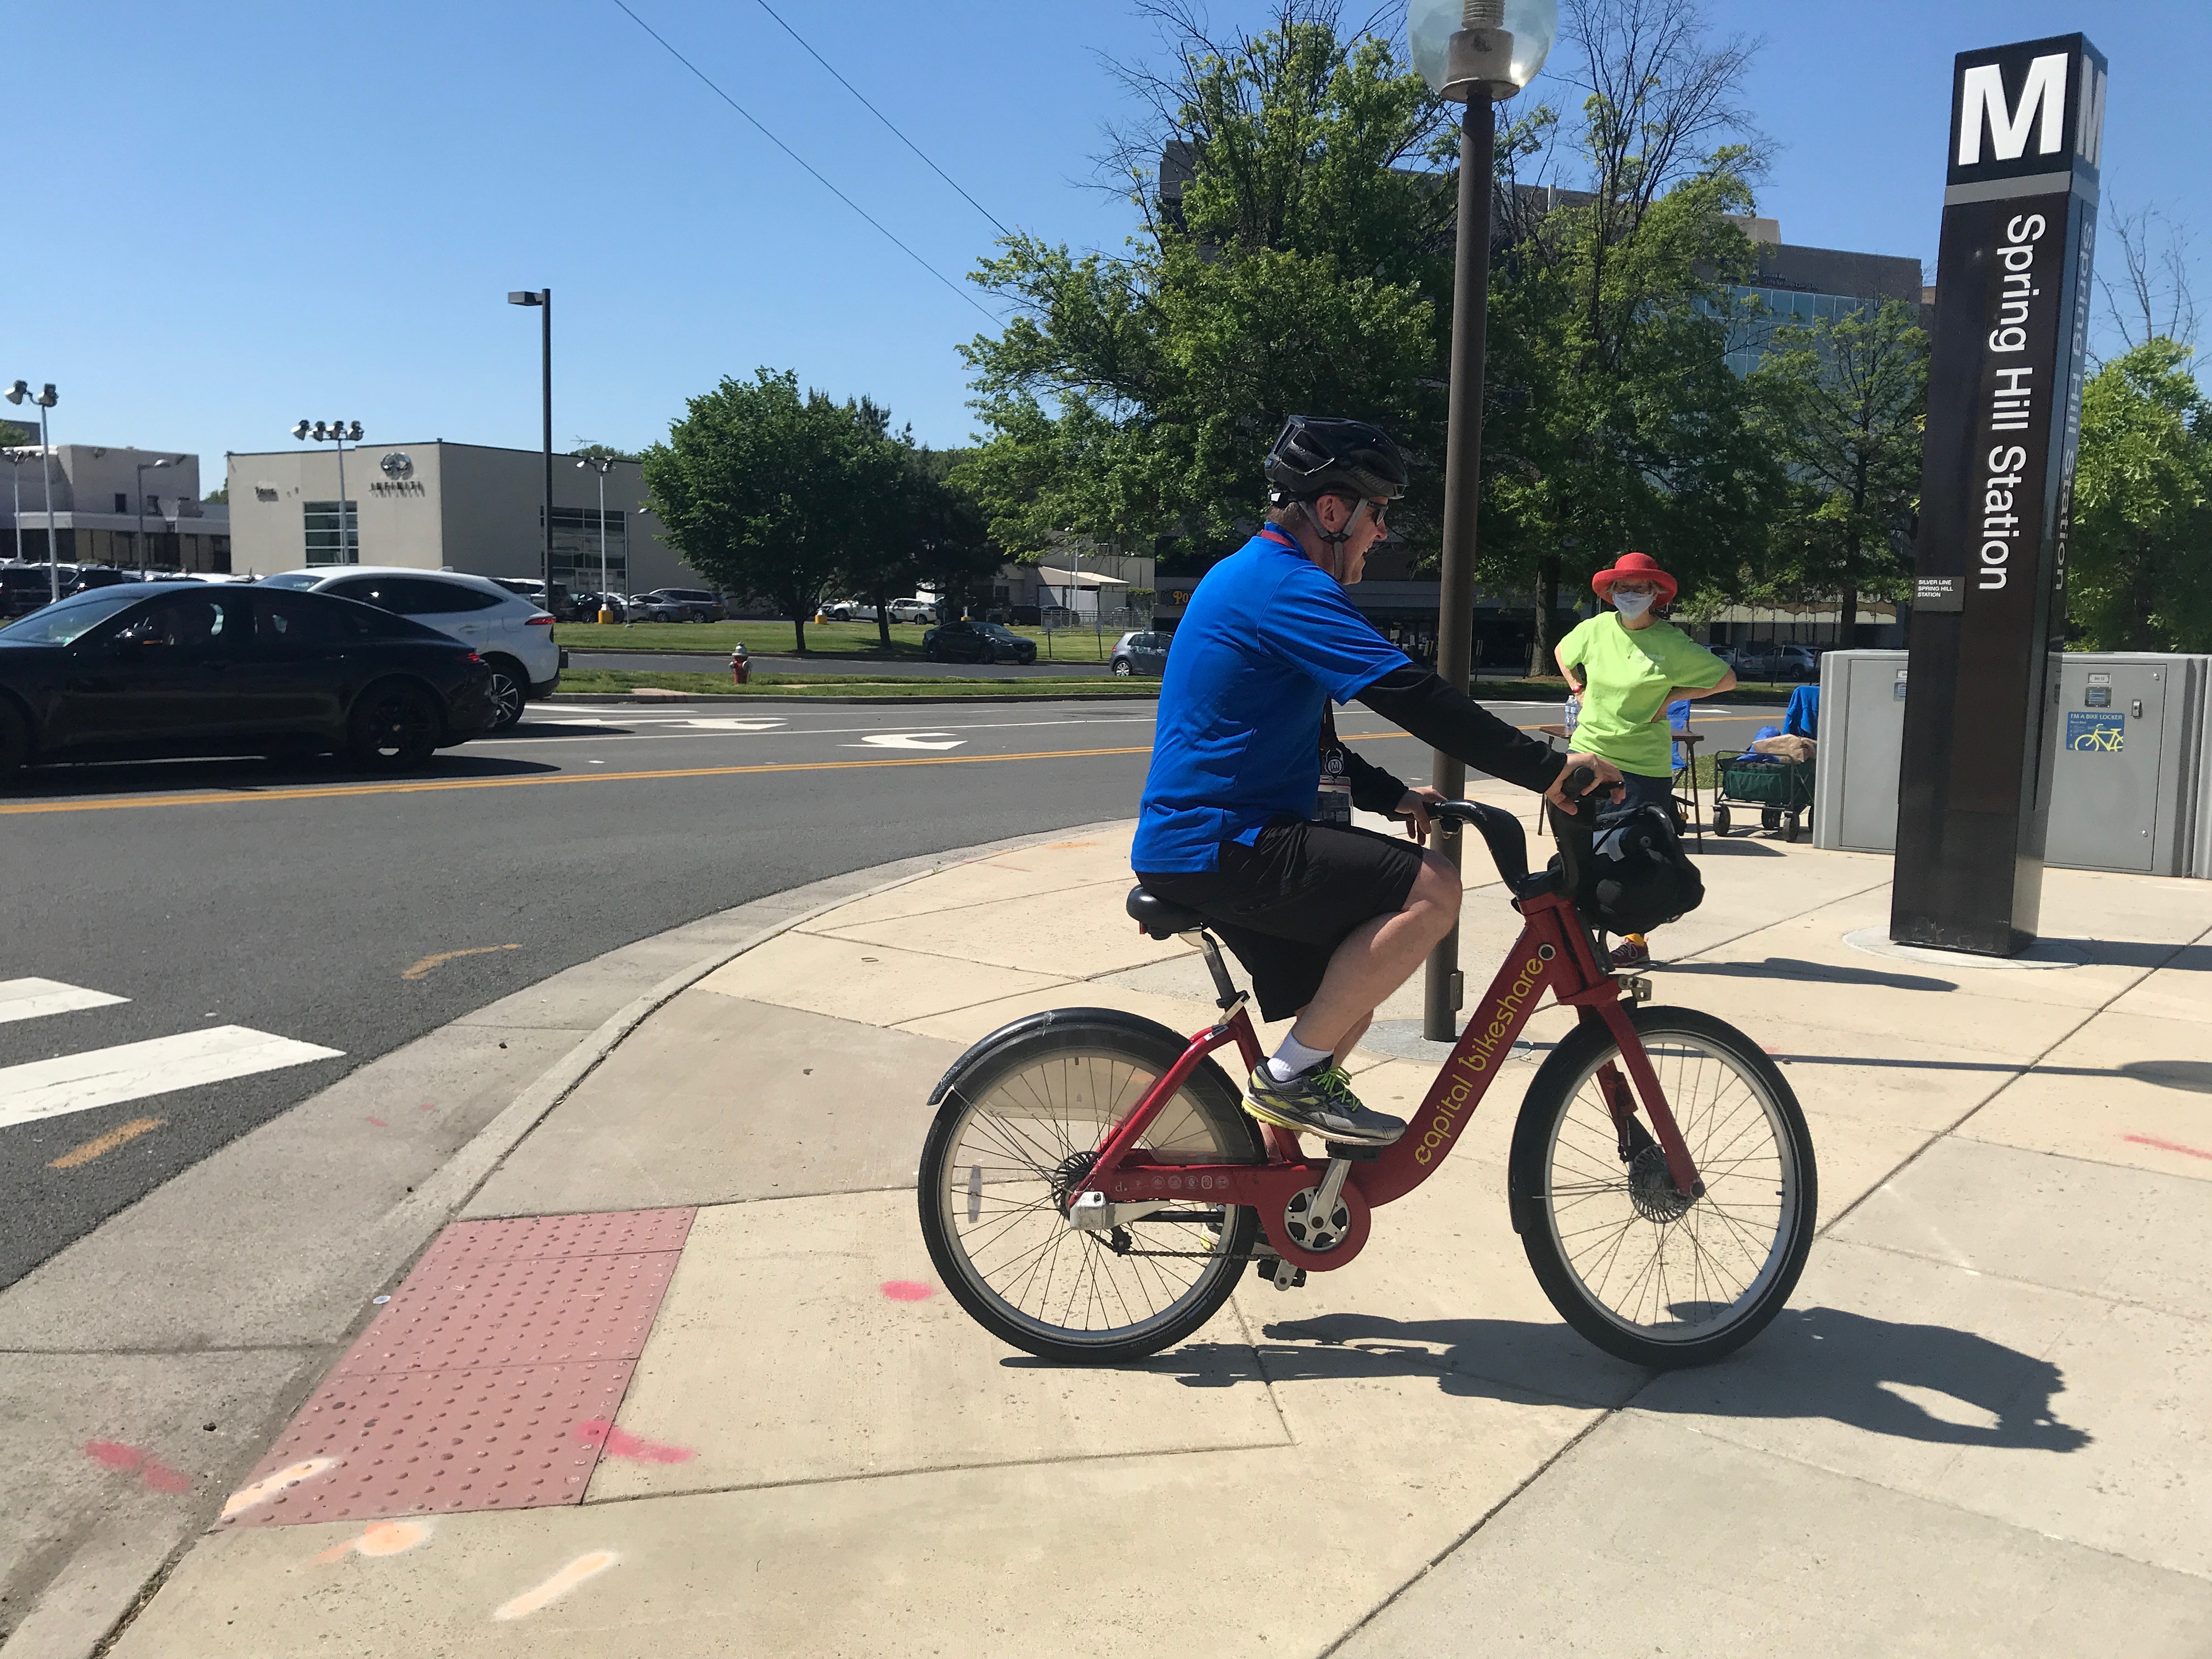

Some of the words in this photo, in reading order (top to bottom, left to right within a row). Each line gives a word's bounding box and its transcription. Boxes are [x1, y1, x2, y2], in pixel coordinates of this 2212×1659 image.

[1959, 53, 2068, 166] M
[2076, 54, 2107, 171] M
[1989, 214, 2046, 352] Spring
[2073, 221, 2093, 357] Spring
[1991, 367, 2033, 430] Hill
[2068, 373, 2081, 434] Hill
[1979, 445, 2027, 590] Station
[2056, 449, 2074, 590] Station
[1331, 761, 1339, 769] M
[1415, 1074, 1473, 1165] capital
[1457, 958, 1543, 1071] bikeshare
